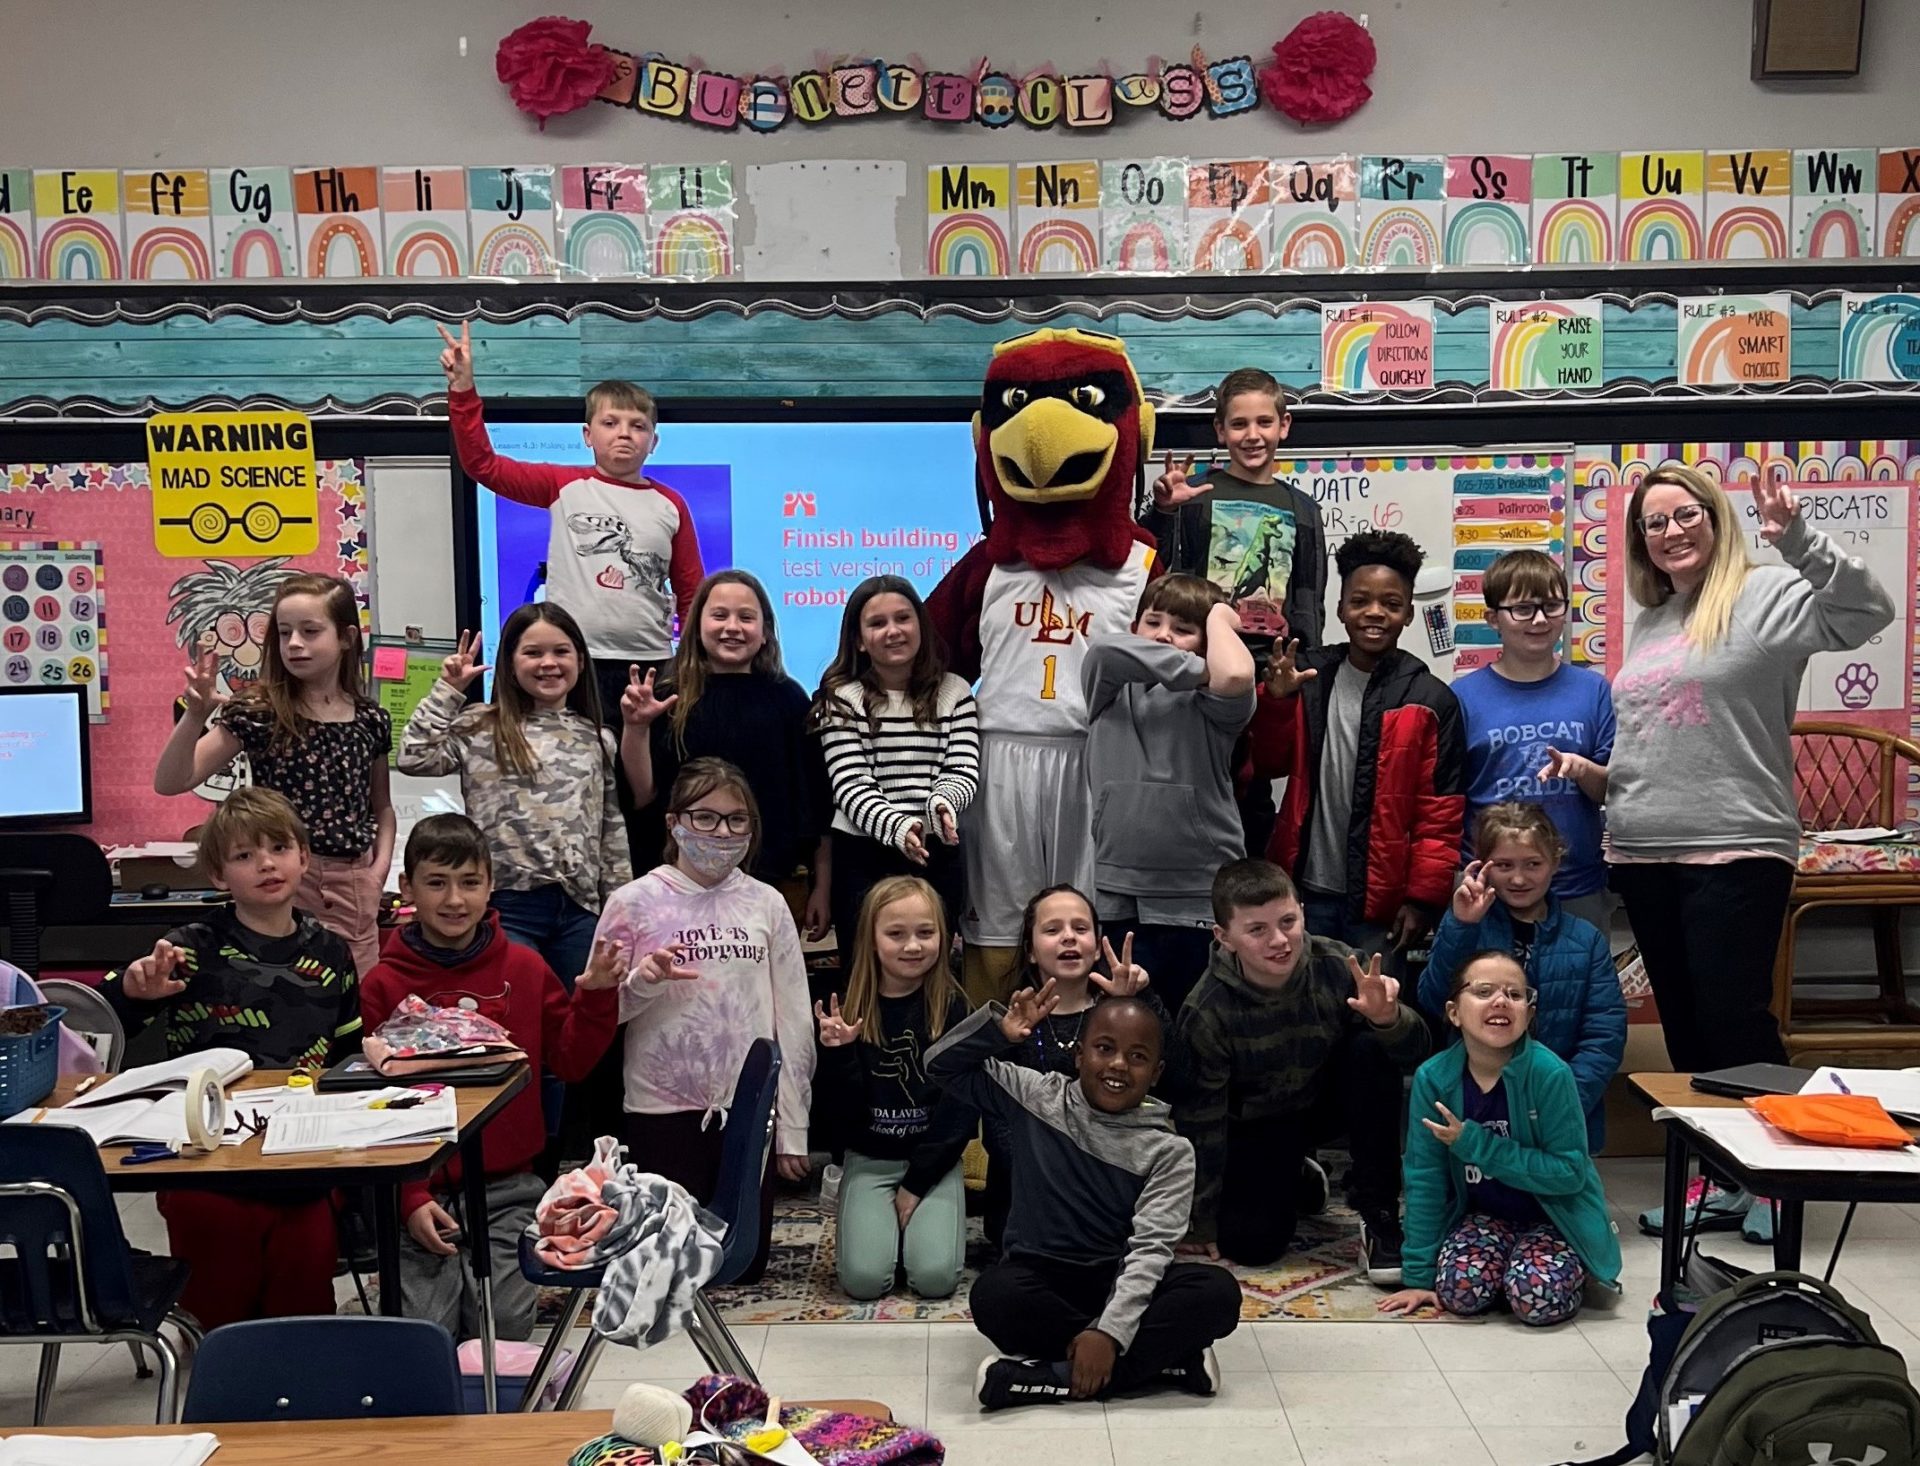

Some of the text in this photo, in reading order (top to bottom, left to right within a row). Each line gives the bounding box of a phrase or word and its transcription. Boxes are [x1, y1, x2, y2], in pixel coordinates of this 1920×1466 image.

[1382, 157, 1425, 200] Rr
[1470, 156, 1508, 199] Ss
[1561, 156, 1594, 198] Tt
[1642, 155, 1682, 195] Uu
[1730, 152, 1769, 194] Vv
[1808, 151, 1862, 193] Ww
[61, 171, 94, 214] Ee
[150, 172, 187, 215] Ff
[229, 169, 272, 223] Gg
[313, 167, 360, 213] Hh
[496, 168, 524, 221] Jj
[941, 165, 995, 210] Mm
[1036, 165, 1079, 207] Nn
[1121, 163, 1165, 206] Oo
[1289, 160, 1340, 213] Qq
[1326, 309, 1374, 323] RULE #1
[1496, 309, 1548, 324] RULE #2
[1684, 303, 1736, 318] RULE #3
[1748, 311, 1775, 327] MAKE
[1385, 323, 1420, 340] FOLLOW
[1558, 317, 1593, 335] RAISE
[1377, 346, 1428, 362] DIRECTIONS
[1561, 342, 1588, 359] YOUR
[1738, 335, 1785, 355] SMART
[1380, 370, 1427, 385] QUICKLY
[1558, 367, 1593, 385] HAND
[1743, 361, 1780, 378] CHOICES
[150, 423, 308, 452] WARNING
[161, 466, 306, 489] MAD SCIENCE
[0, 506, 35, 529] ary
[1498, 502, 1549, 515] Bathroom
[1800, 495, 1888, 520] OBCATS
[783, 528, 853, 548] Finish
[862, 528, 958, 551] building
[1498, 526, 1531, 538] Switch
[76, 571, 85, 586] 5
[783, 558, 822, 577] test
[829, 557, 904, 577] version
[913, 557, 935, 577] of
[783, 587, 847, 606] robot
[42, 602, 54, 617] 11
[75, 600, 89, 617] 12
[10, 630, 90, 646] 17 18 19
[9, 660, 91, 681] 24 25 26
[1041, 654, 1056, 700] 1
[1487, 720, 1585, 754] BOBCAT
[1494, 775, 1579, 799] PRIDE
[672, 923, 749, 946] LOVE IS
[672, 944, 766, 966] STOPPABLE
